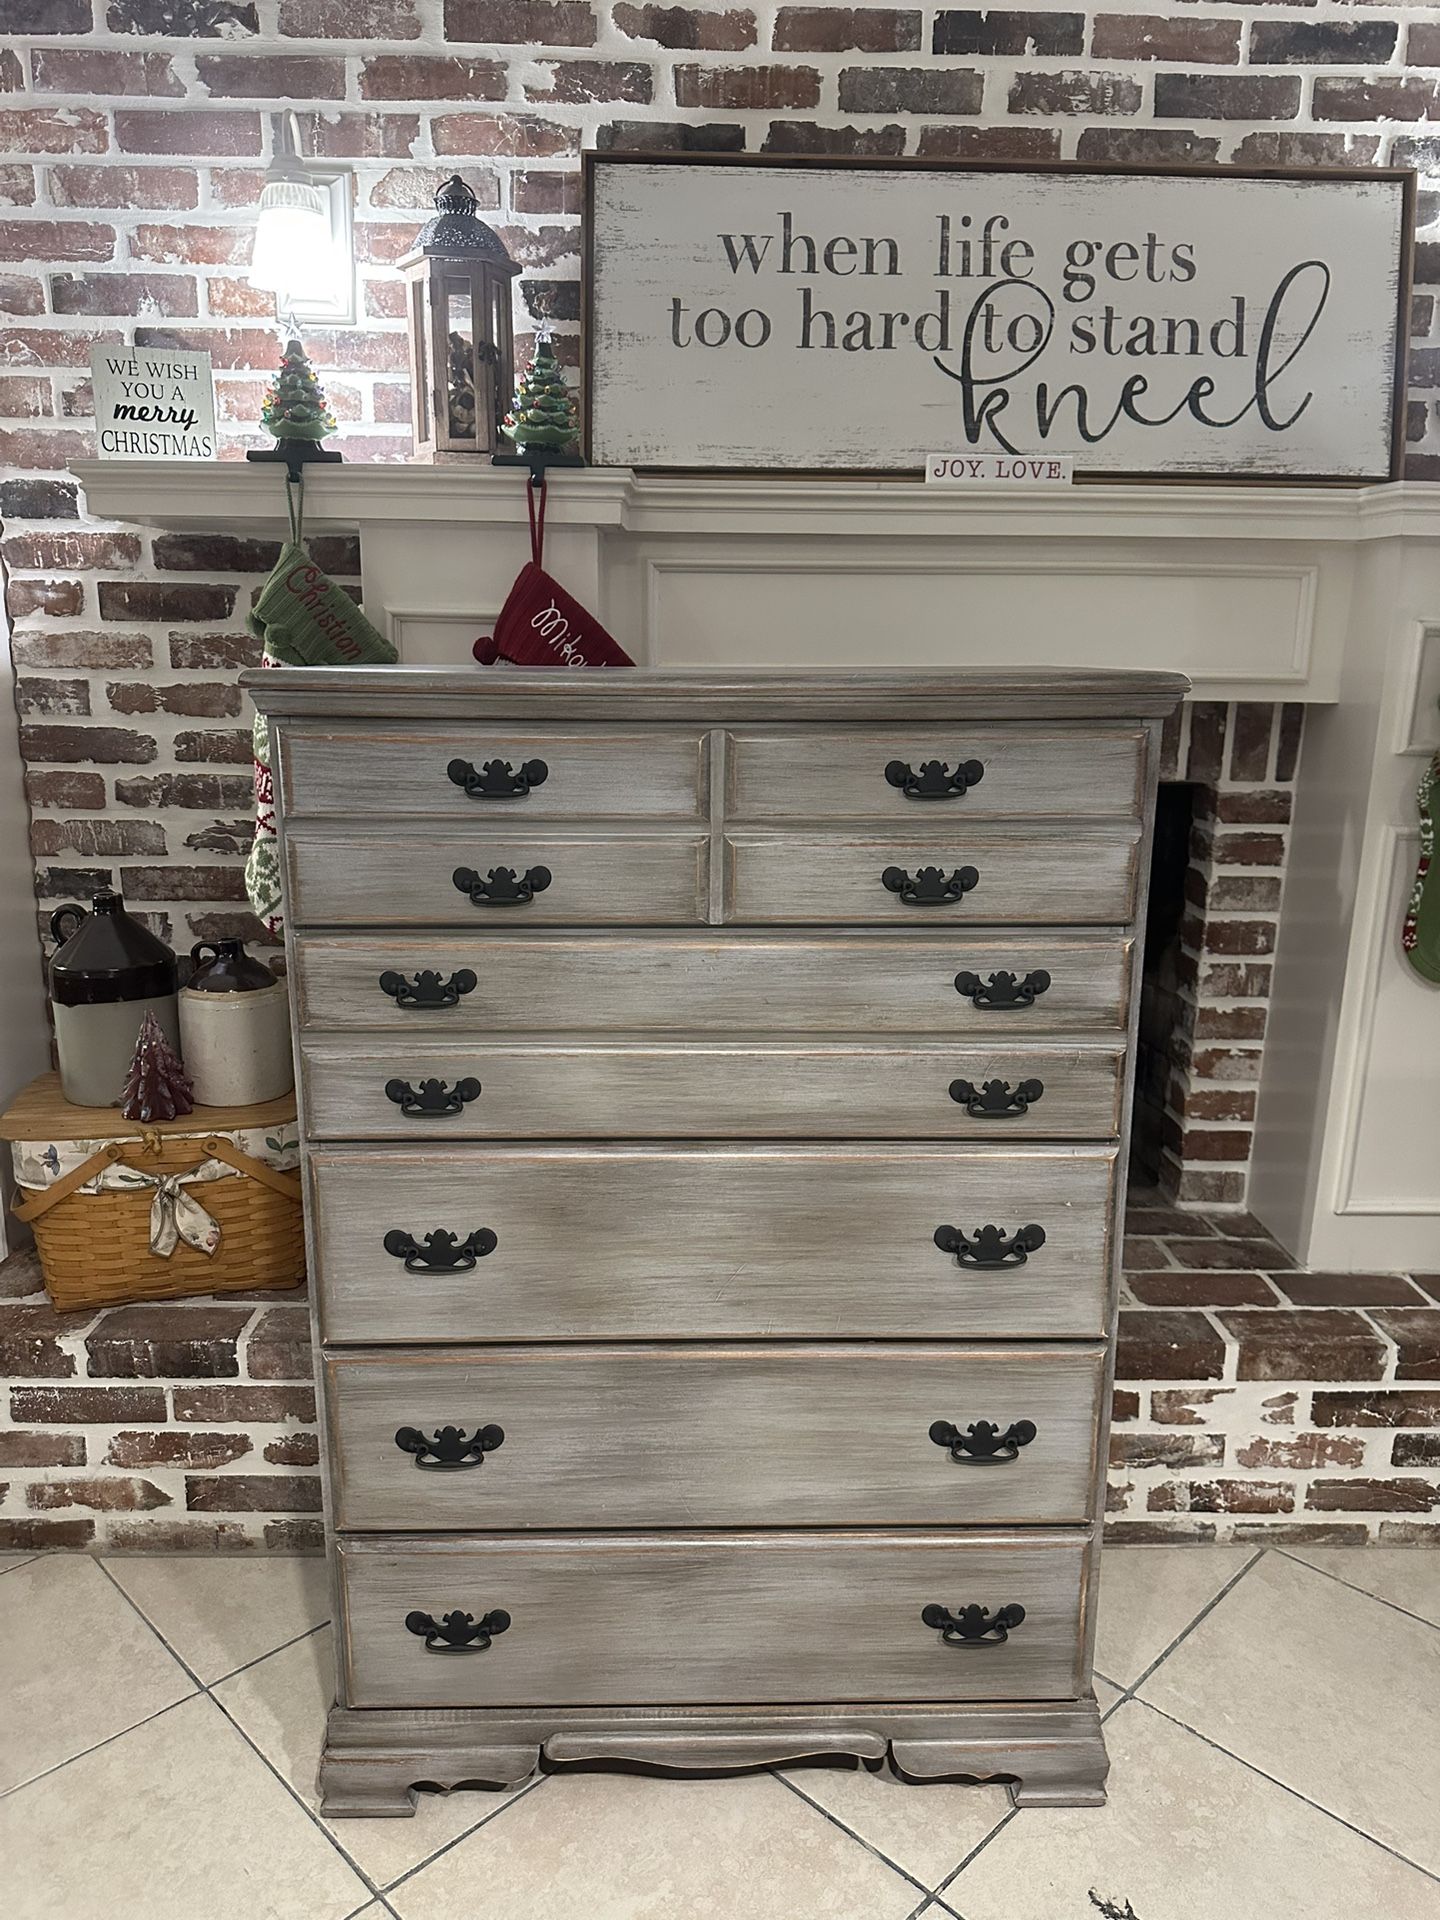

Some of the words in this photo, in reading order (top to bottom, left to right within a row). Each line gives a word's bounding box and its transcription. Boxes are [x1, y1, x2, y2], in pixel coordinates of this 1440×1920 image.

[717, 212, 902, 275] when
[932, 214, 1035, 279] life
[1062, 232, 1197, 303] gets
[667, 297, 772, 348] too
[796, 287, 953, 352] hard
[980, 303, 1044, 353] to
[1069, 296, 1249, 358] stand
[105, 358, 140, 377] WE
[145, 362, 198, 380] WISH
[933, 260, 1331, 456] kneel
[121, 381, 164, 400] YOU
[171, 386, 185, 401] A
[113, 403, 199, 431] merry
[101, 430, 212, 457] CHRISTMAS
[934, 459, 985, 478] JOY.
[995, 460, 1066, 479] LOVE.
[286, 566, 362, 661] Christian
